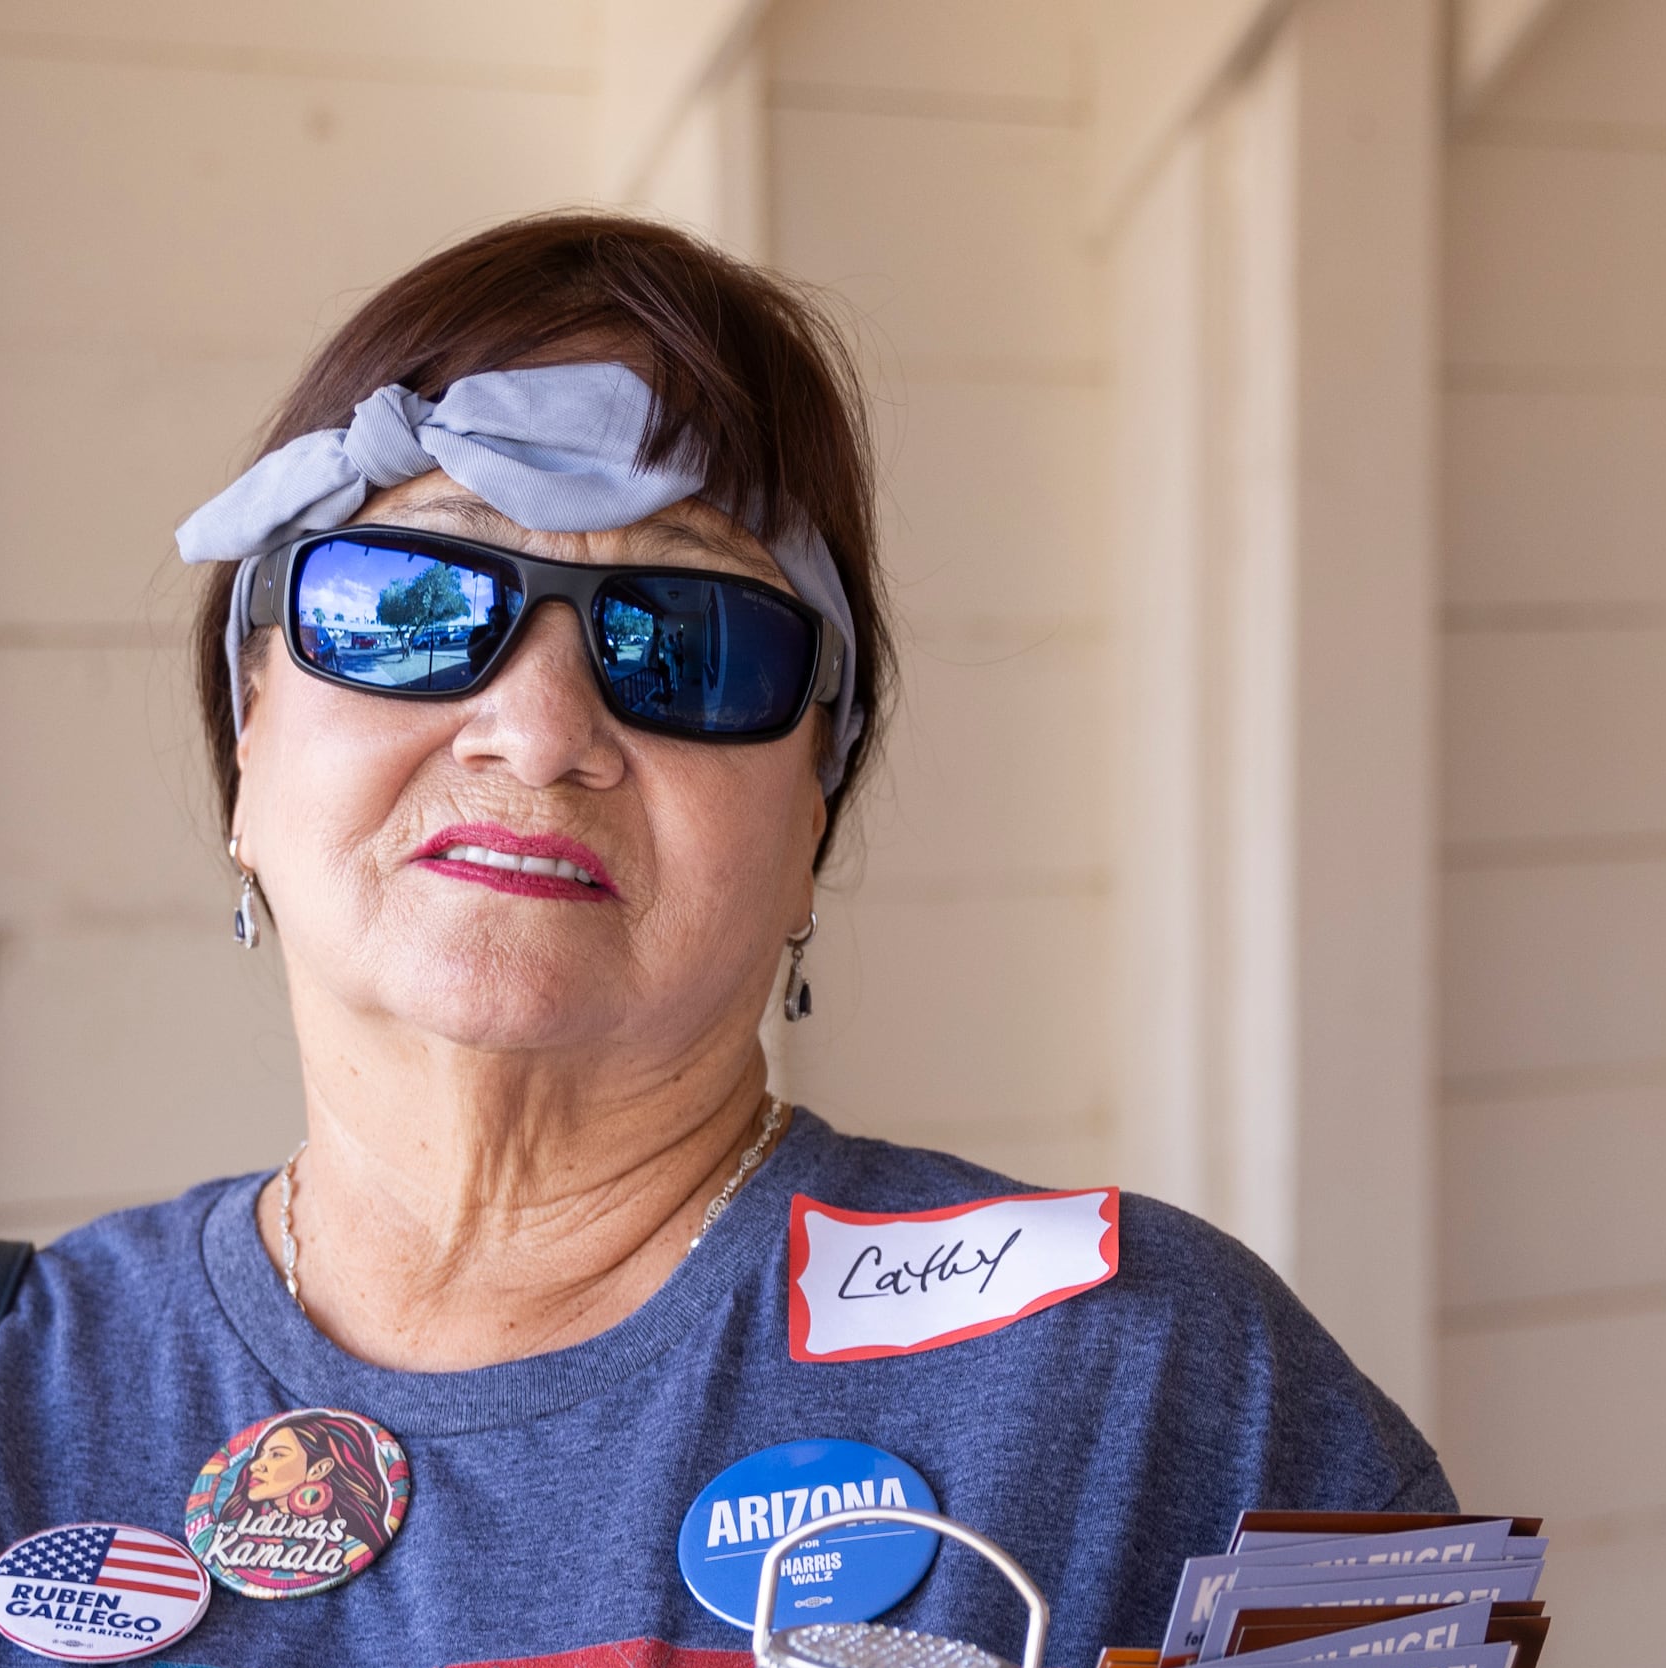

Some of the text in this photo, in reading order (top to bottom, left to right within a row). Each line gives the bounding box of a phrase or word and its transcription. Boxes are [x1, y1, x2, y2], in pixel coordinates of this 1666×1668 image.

[838, 1227, 1023, 1300] Cathy
[236, 1507, 348, 1543] Latinas
[706, 1476, 909, 1549] ARIZONA
[216, 1521, 235, 1534] for
[202, 1530, 344, 1574] Kamala
[798, 1539, 820, 1550] FOR
[780, 1551, 843, 1577] HARRIS
[790, 1570, 833, 1586] WALZ
[10, 1583, 122, 1611] RUBEN
[4, 1600, 162, 1633] GALLEGO
[54, 1622, 83, 1633] FOR
[87, 1627, 155, 1644] ARIZONA
